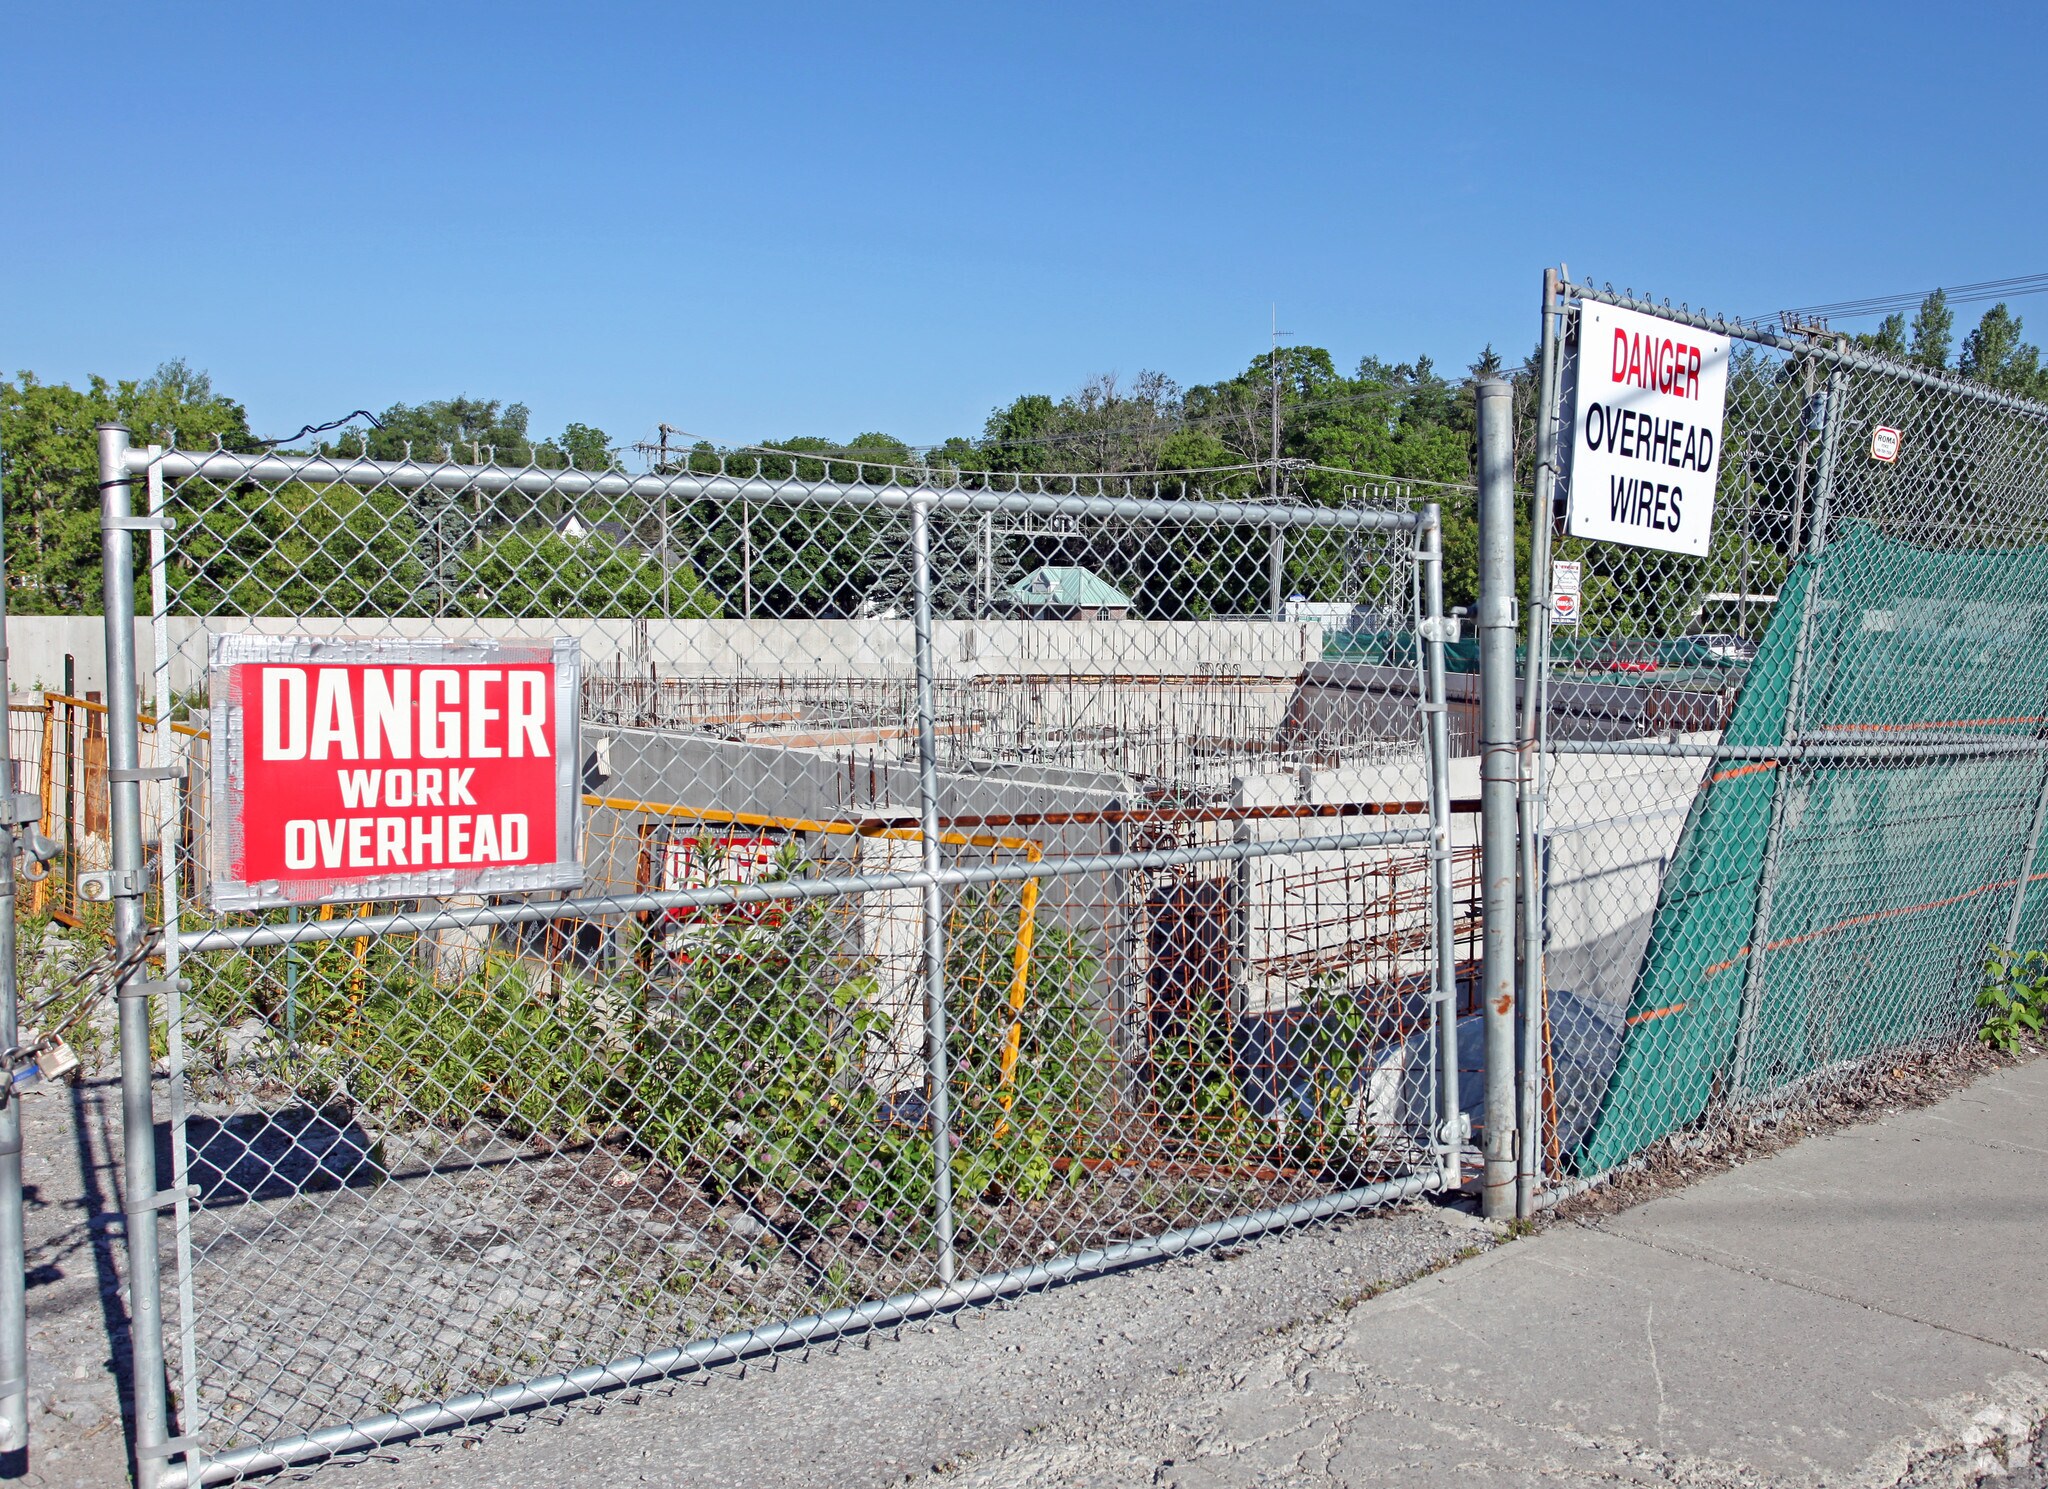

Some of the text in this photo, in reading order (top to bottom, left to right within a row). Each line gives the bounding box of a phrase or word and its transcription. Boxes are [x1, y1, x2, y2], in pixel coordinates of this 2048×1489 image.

[1612, 327, 1701, 400] DANGER
[1585, 402, 1713, 473] OVERHEAD
[1878, 434, 1896, 445] ROMA
[1610, 475, 1683, 532] WIRES
[262, 667, 551, 761] DANGER
[337, 767, 477, 808] WORK
[285, 813, 529, 870] OVERHEAD
